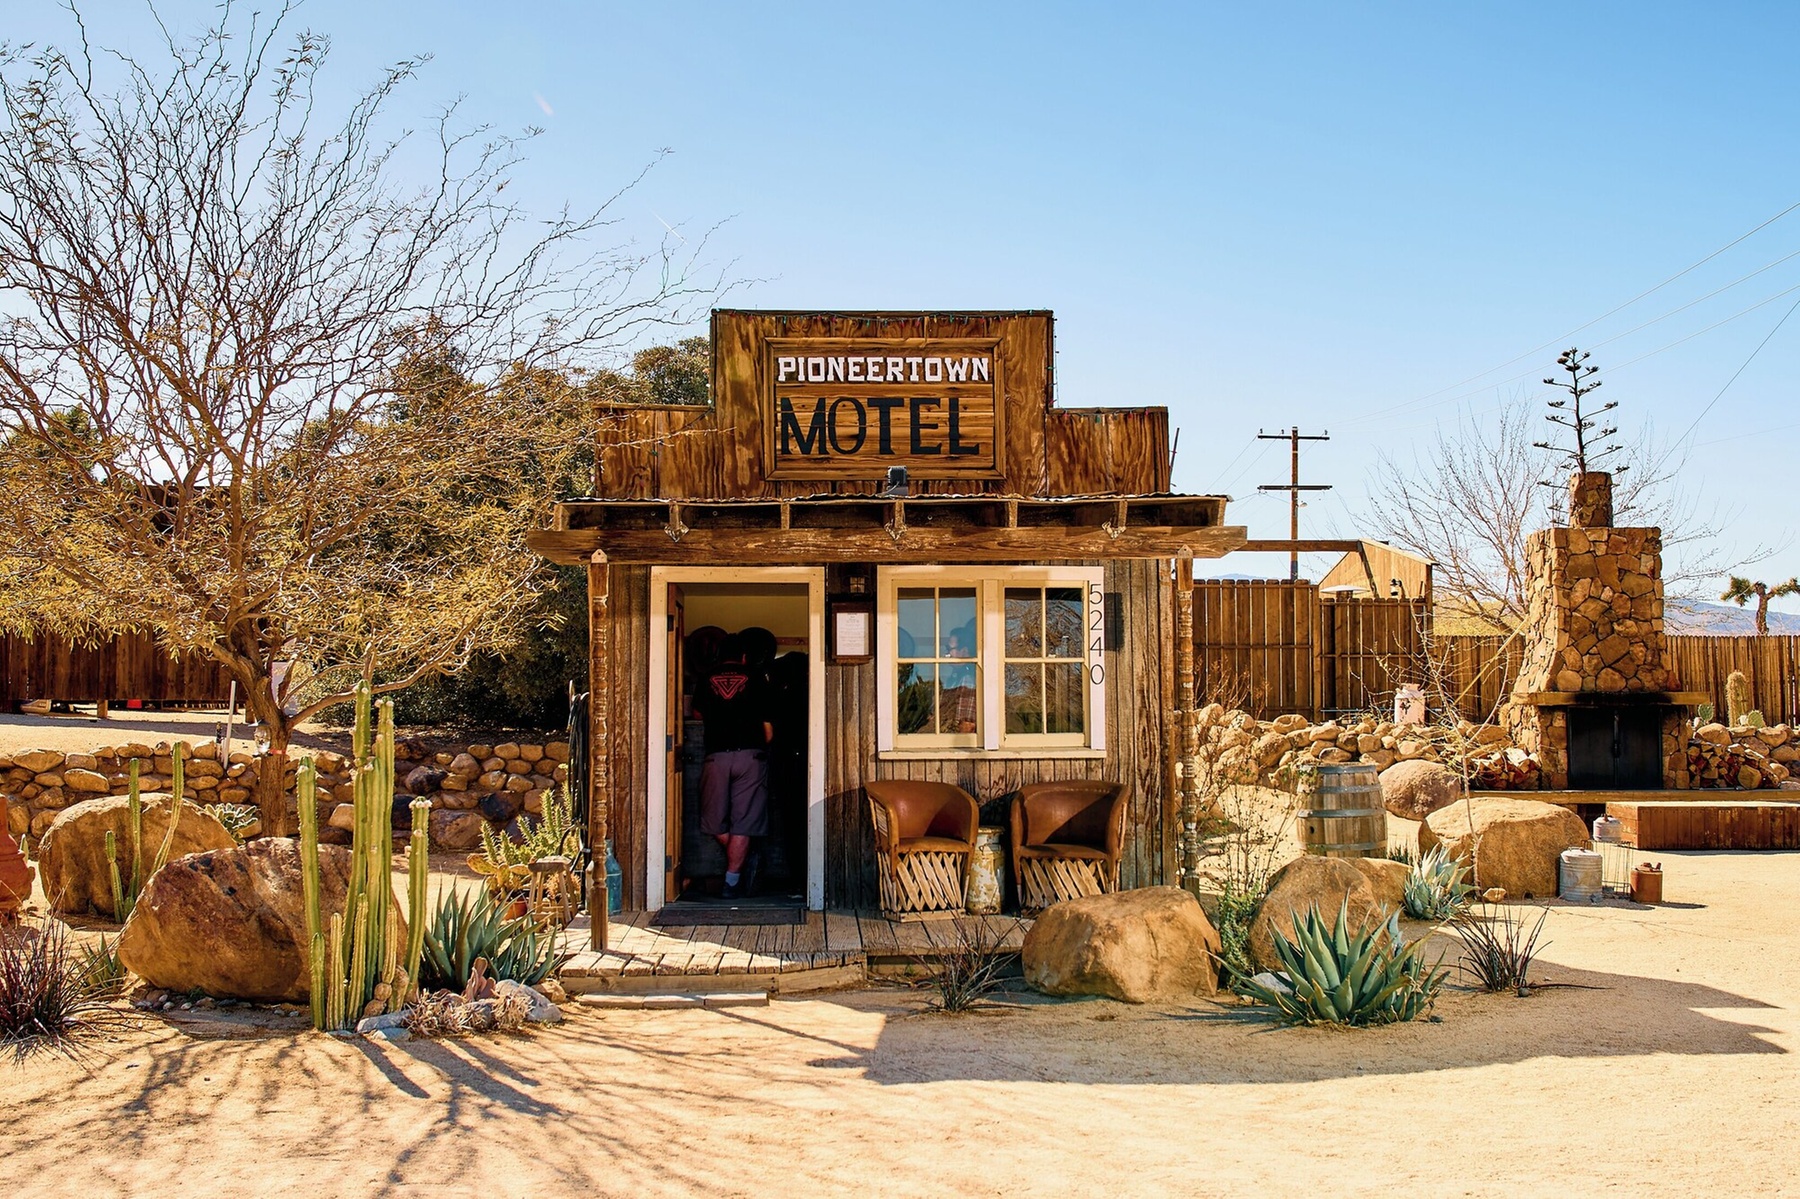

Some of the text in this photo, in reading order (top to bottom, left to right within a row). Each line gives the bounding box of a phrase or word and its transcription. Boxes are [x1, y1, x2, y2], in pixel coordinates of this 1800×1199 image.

[778, 356, 989, 382] PIONEERTOWN
[780, 397, 980, 455] MOTEL
[1089, 583, 1105, 686] 5240
